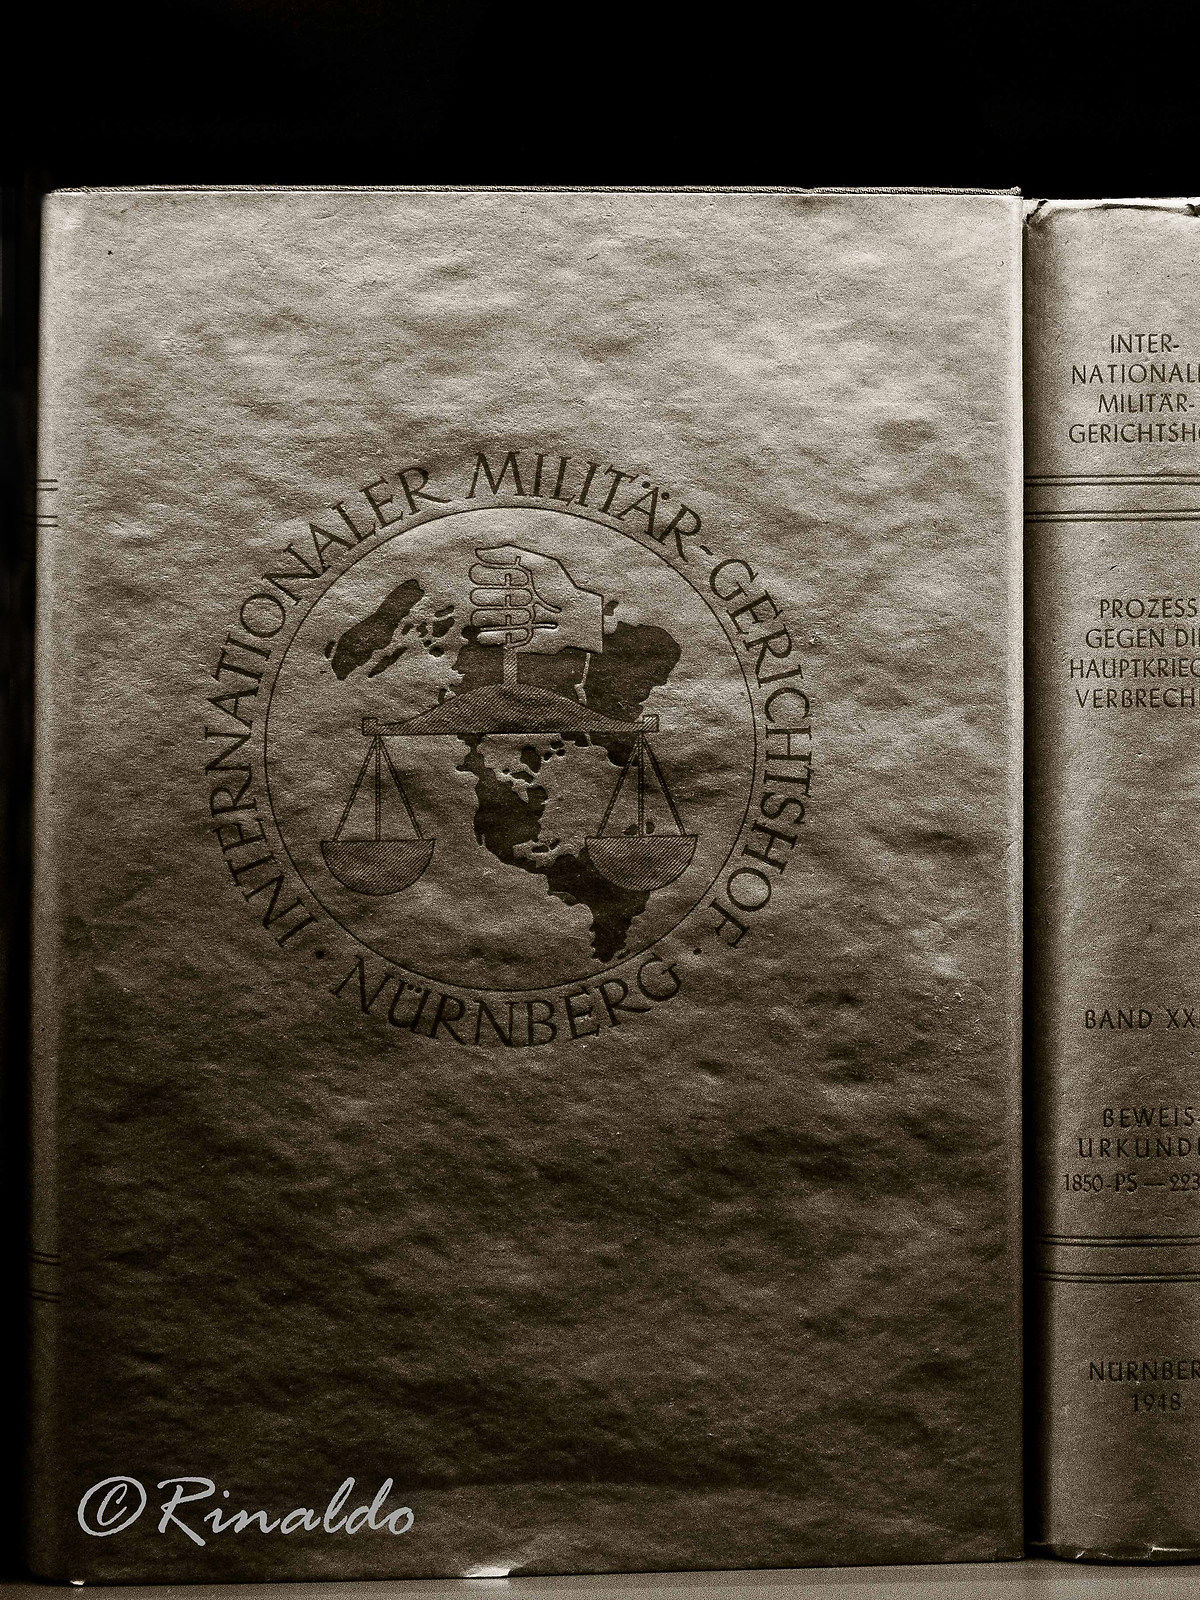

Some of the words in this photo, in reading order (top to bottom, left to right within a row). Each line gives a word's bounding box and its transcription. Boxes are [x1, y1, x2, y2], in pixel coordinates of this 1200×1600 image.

[1110, 332, 1179, 354] INTER-
[1097, 393, 1195, 414] MILITÄR-
[1099, 598, 1199, 619] PROZESS
[1085, 629, 1162, 649] GEGEN
[204, 465, 451, 948] INTERNATIONALER
[465, 451, 813, 951] MILITÄR-GERICHTSHOF
[330, 953, 682, 1049] NÜRNBERG
[1084, 1009, 1152, 1029] BAND
[1132, 1392, 1182, 1413] 1948
